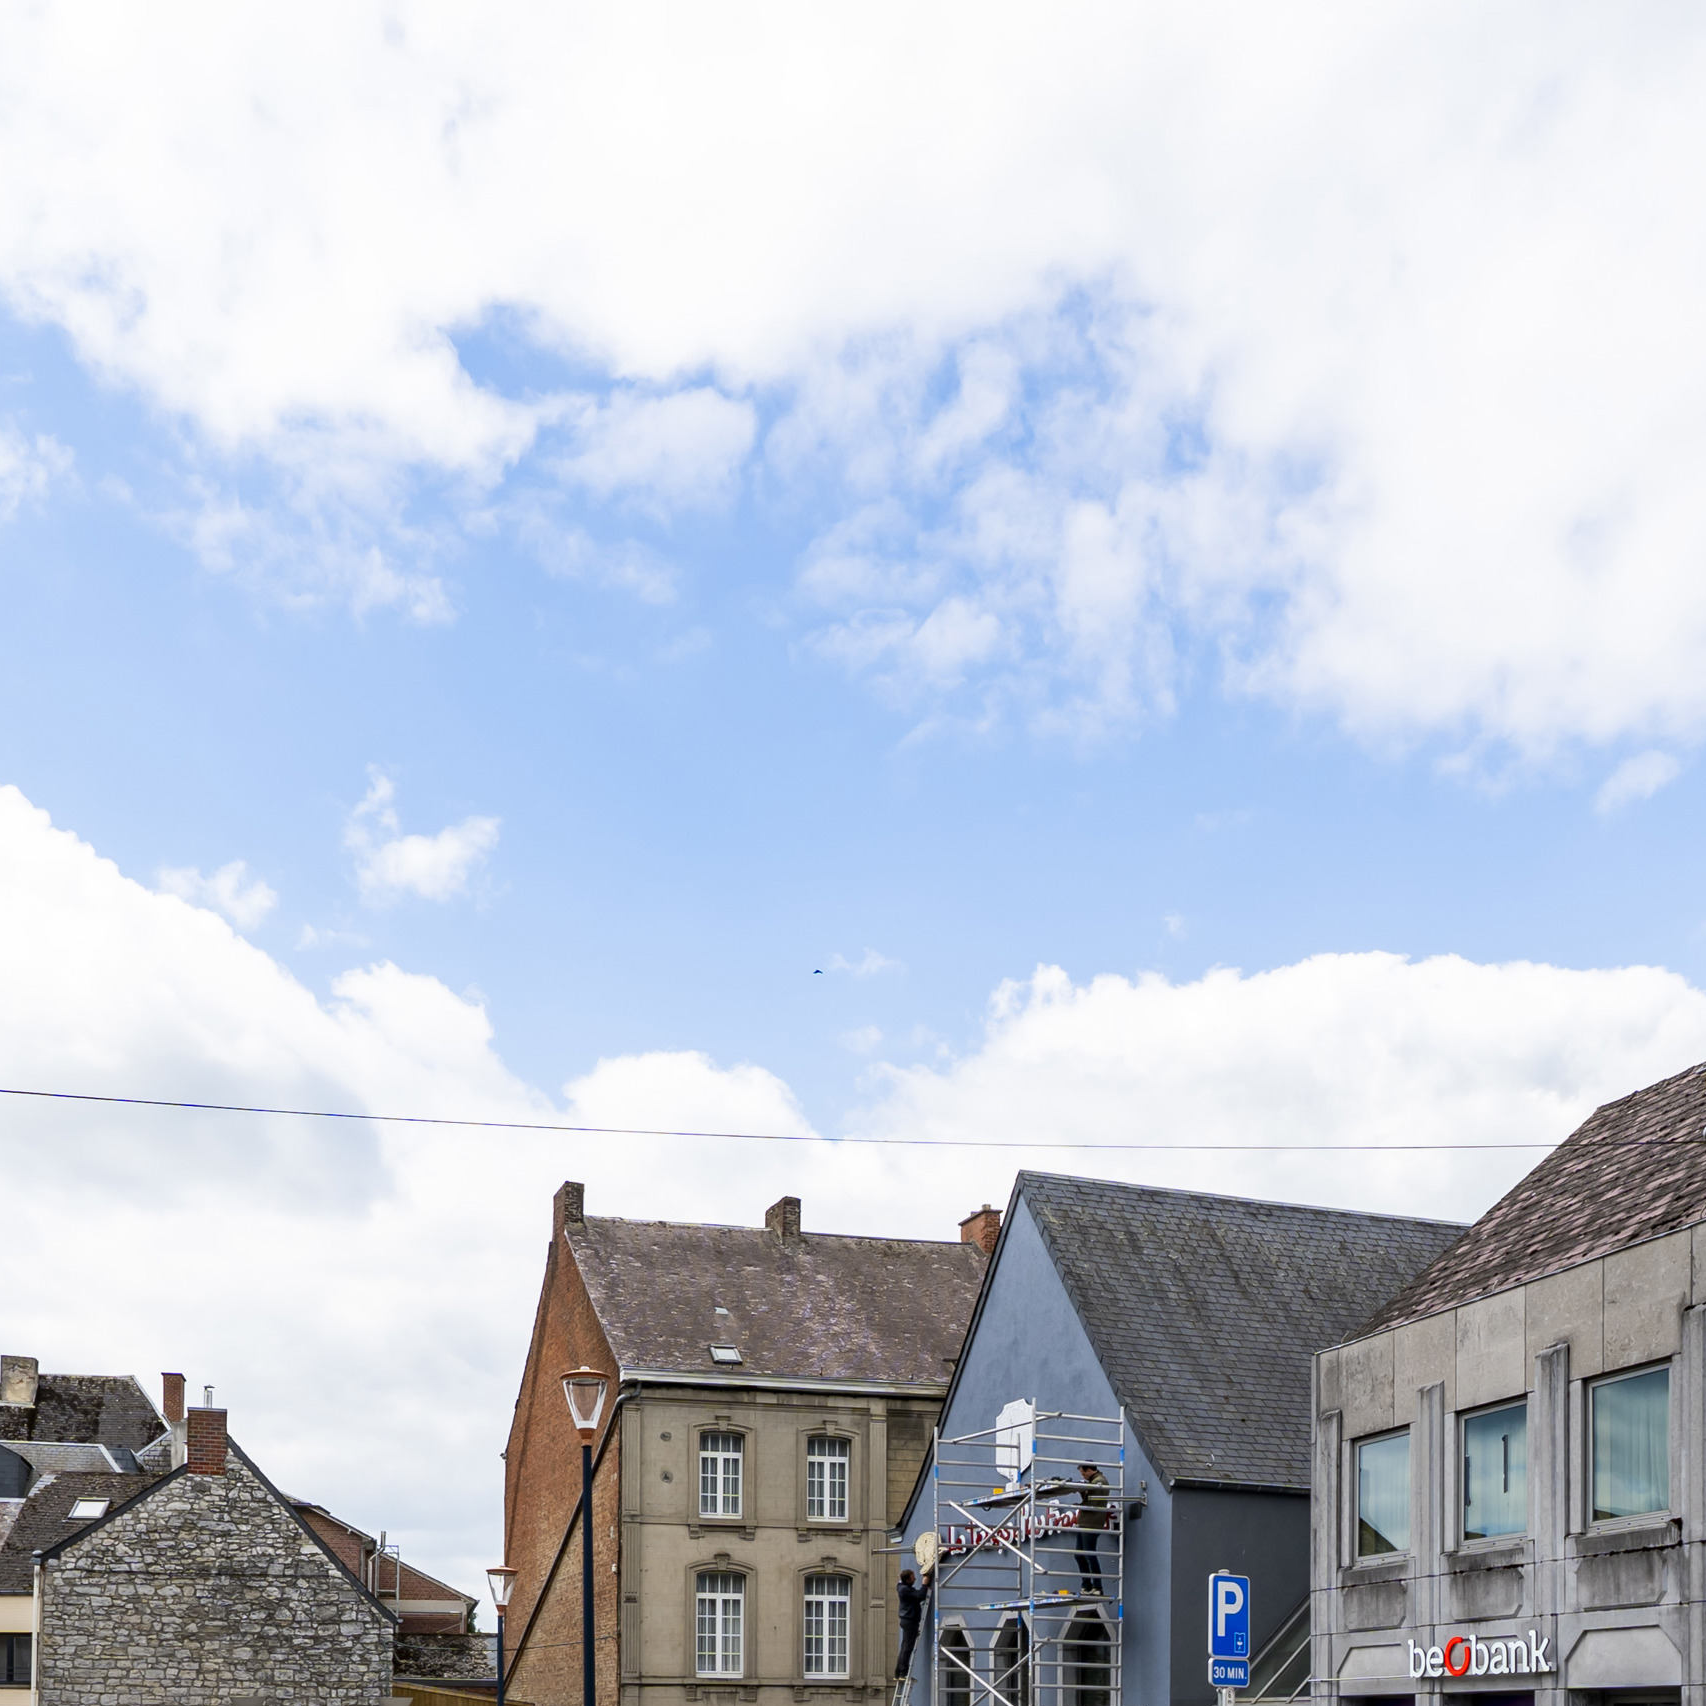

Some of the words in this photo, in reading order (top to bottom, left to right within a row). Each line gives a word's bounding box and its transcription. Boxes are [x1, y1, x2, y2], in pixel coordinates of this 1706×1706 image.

[1217, 1581, 1243, 1637] P
[1213, 1666, 1226, 1679] 30
[1227, 1667, 1247, 1680] MIN.
